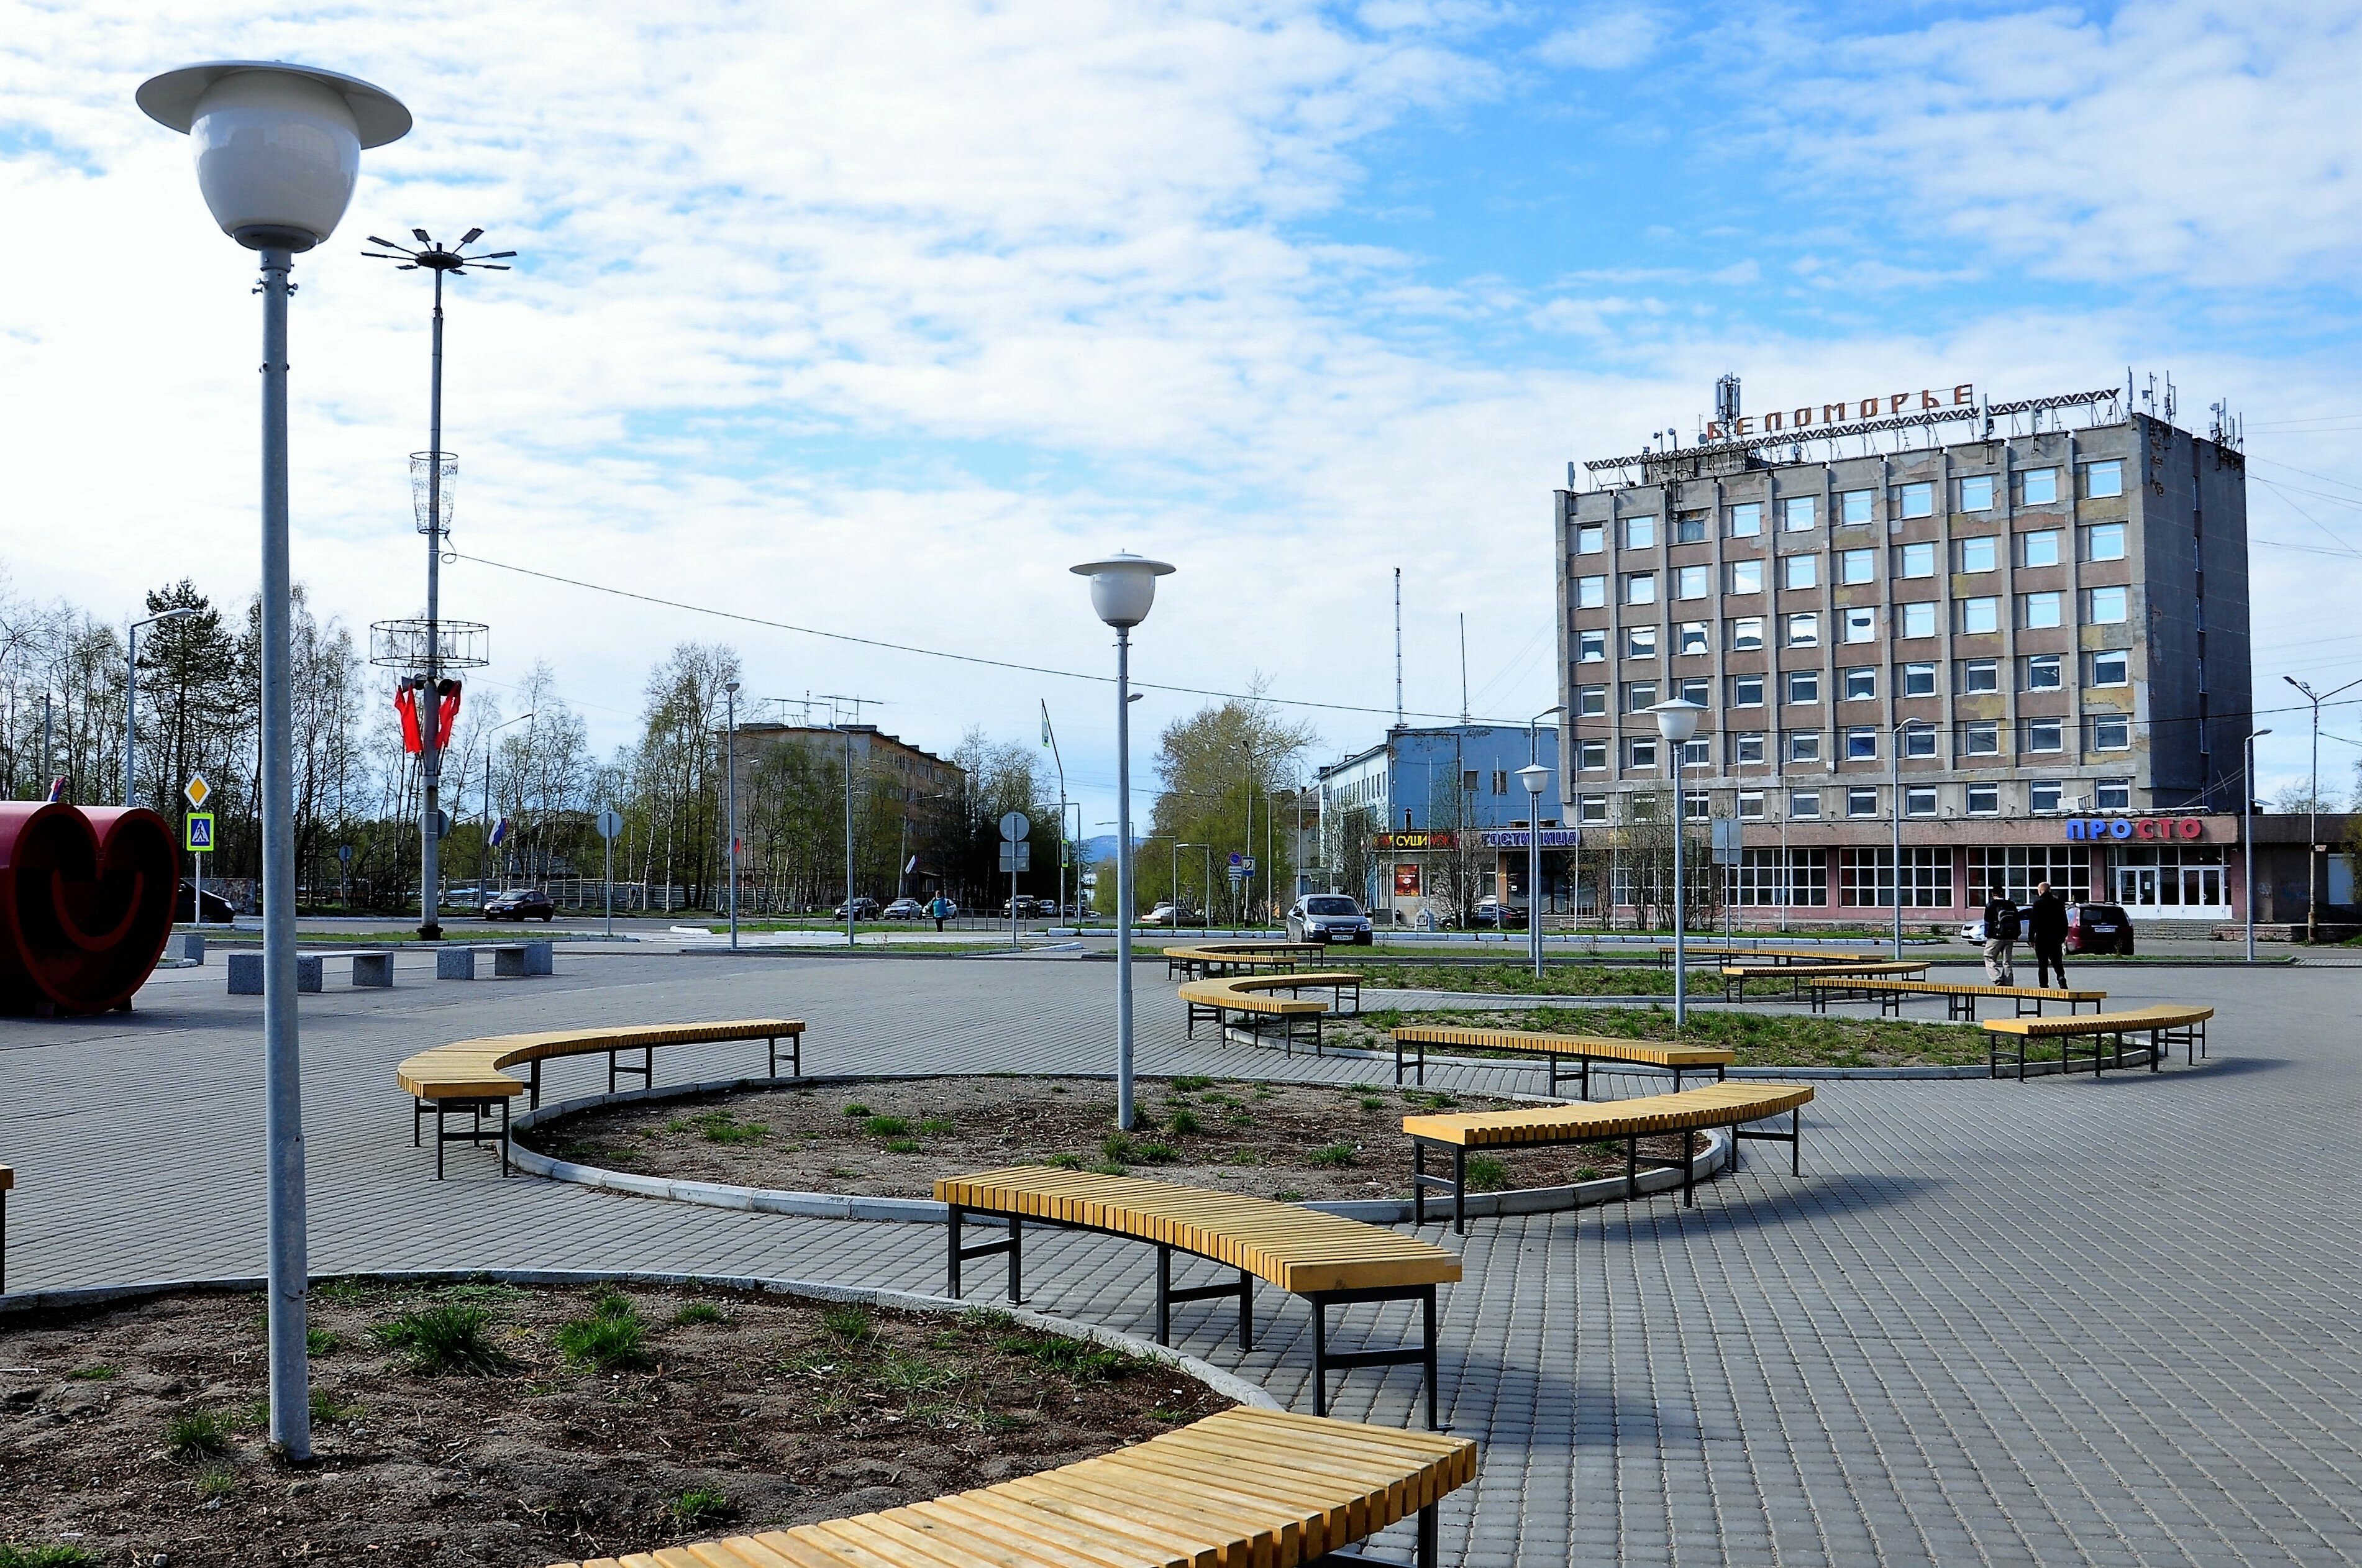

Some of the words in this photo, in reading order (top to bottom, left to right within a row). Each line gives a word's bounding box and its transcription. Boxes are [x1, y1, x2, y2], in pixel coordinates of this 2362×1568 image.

[1707, 383, 1973, 440] БЕЛОМОРЬЕ
[2066, 818, 2202, 840] ПРОСТО
[1396, 835, 1428, 847] СУШИ
[1481, 831, 1579, 846] ГОСТИИЦА
